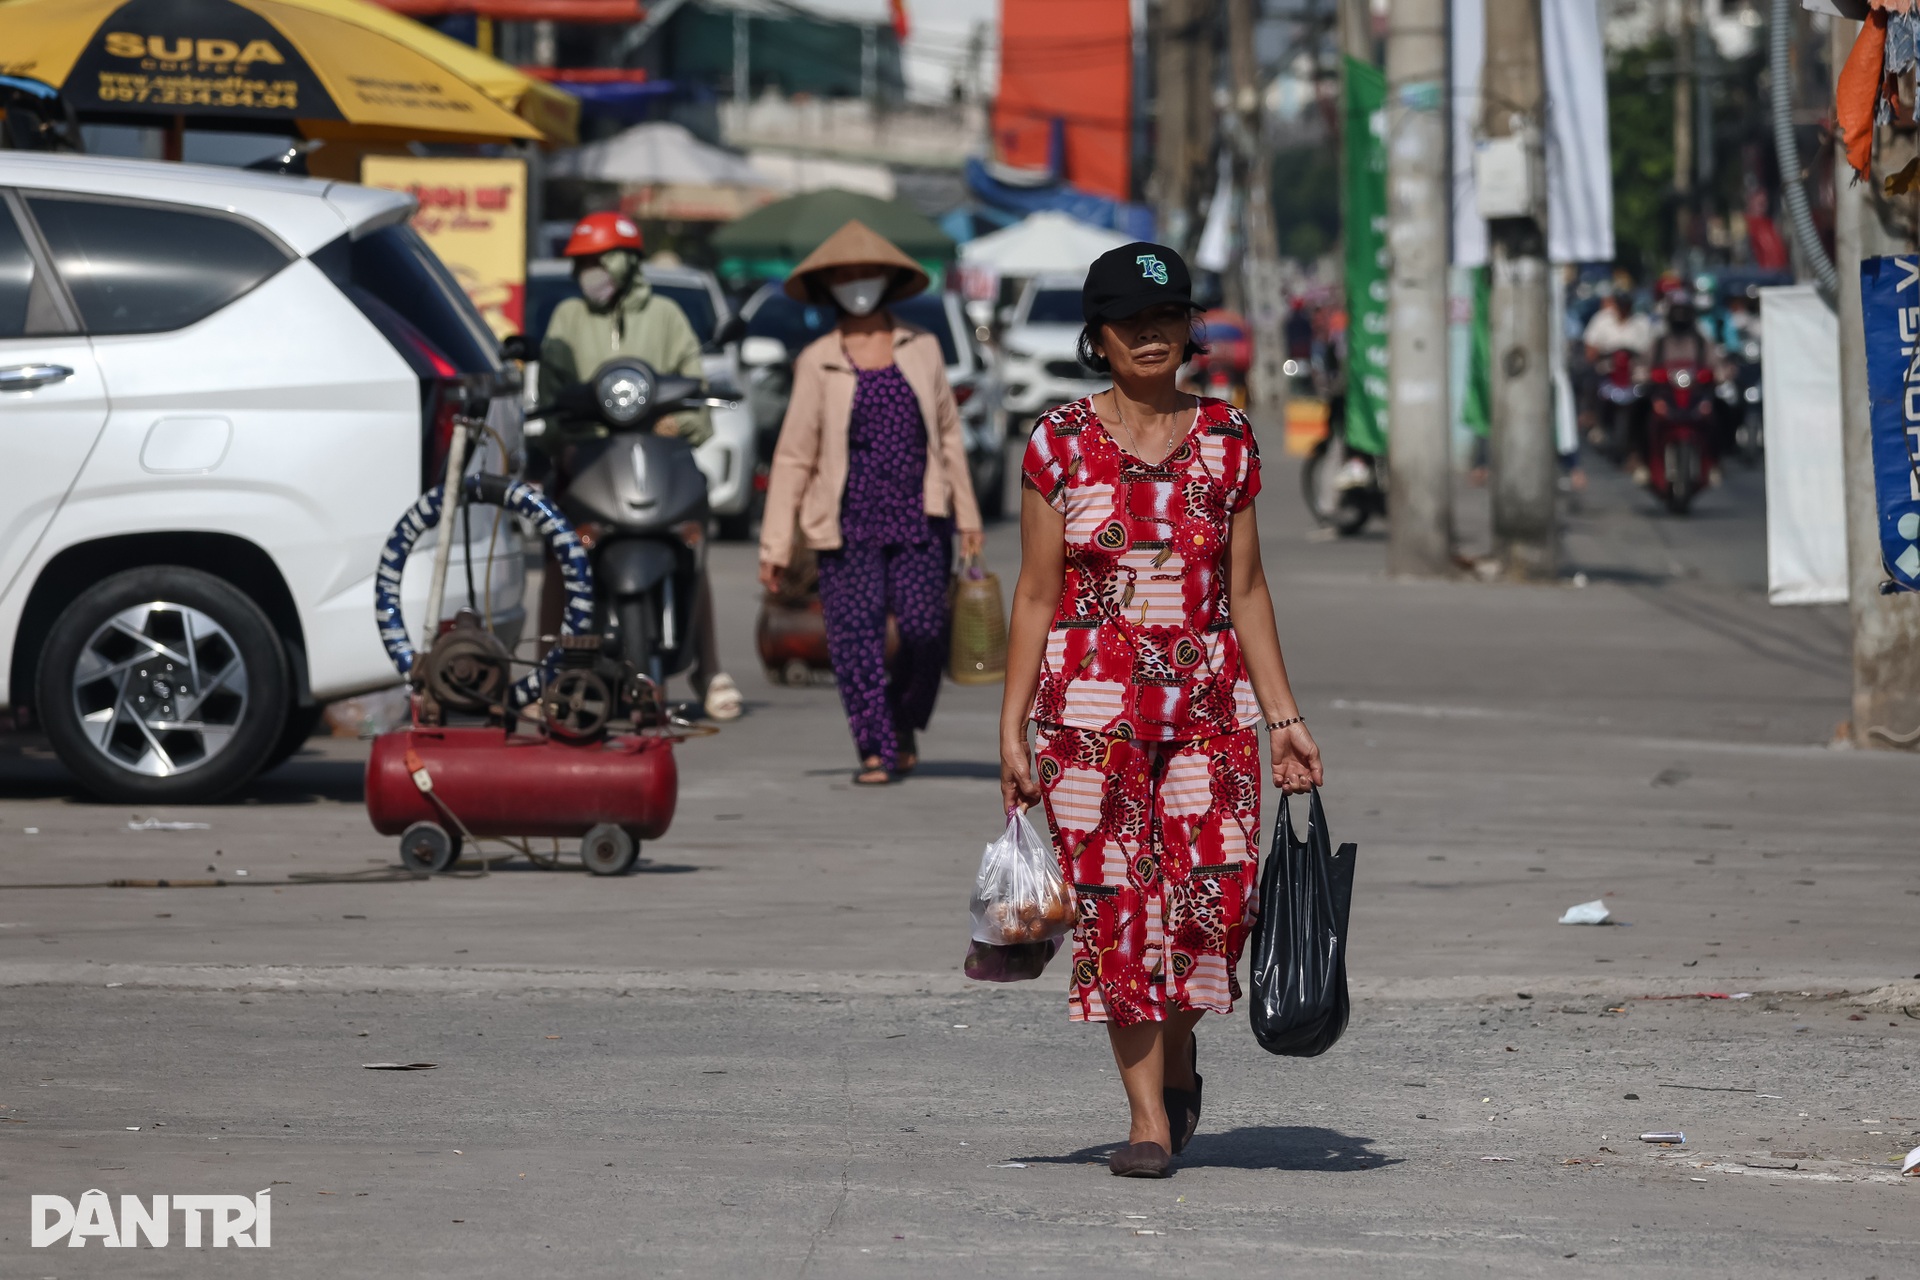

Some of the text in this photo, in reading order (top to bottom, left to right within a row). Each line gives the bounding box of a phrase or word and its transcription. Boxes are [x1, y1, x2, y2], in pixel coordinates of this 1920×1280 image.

[105, 32, 285, 64] SUDA
[141, 58, 248, 74] COFFEE
[1136, 254, 1168, 284] TS
